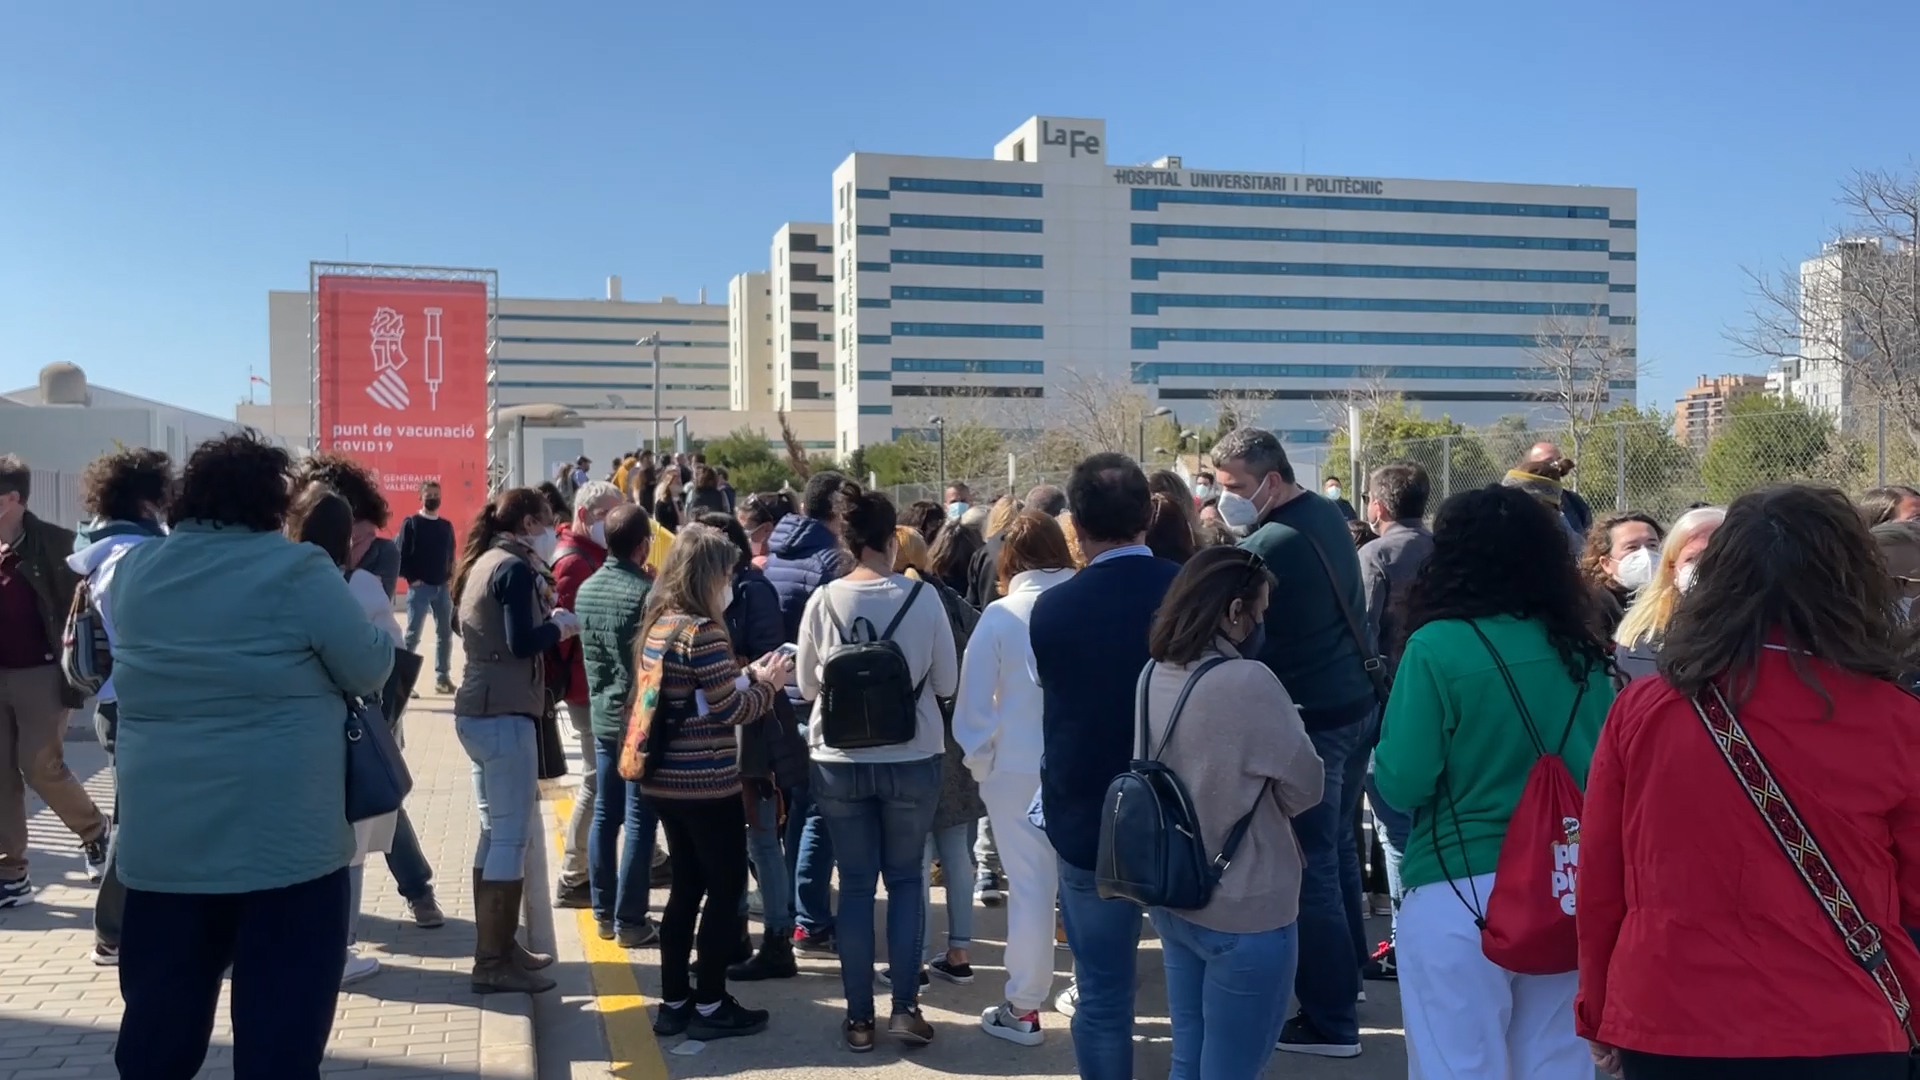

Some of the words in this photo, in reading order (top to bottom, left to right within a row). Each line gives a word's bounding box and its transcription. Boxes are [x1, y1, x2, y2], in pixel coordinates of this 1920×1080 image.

[1113, 168, 1182, 187] HOSPITAL
[1190, 173, 1287, 192] UNIVERSITARI
[1293, 178, 1298, 192] I
[1305, 176, 1384, 195] POLITÈCNIC
[333, 423, 369, 438] punt
[373, 423, 392, 437] de
[397, 424, 475, 438] vacunació
[333, 440, 393, 452] COVID19
[383, 474, 441, 482] GENERALITAT
[385, 483, 418, 491] VALENC
